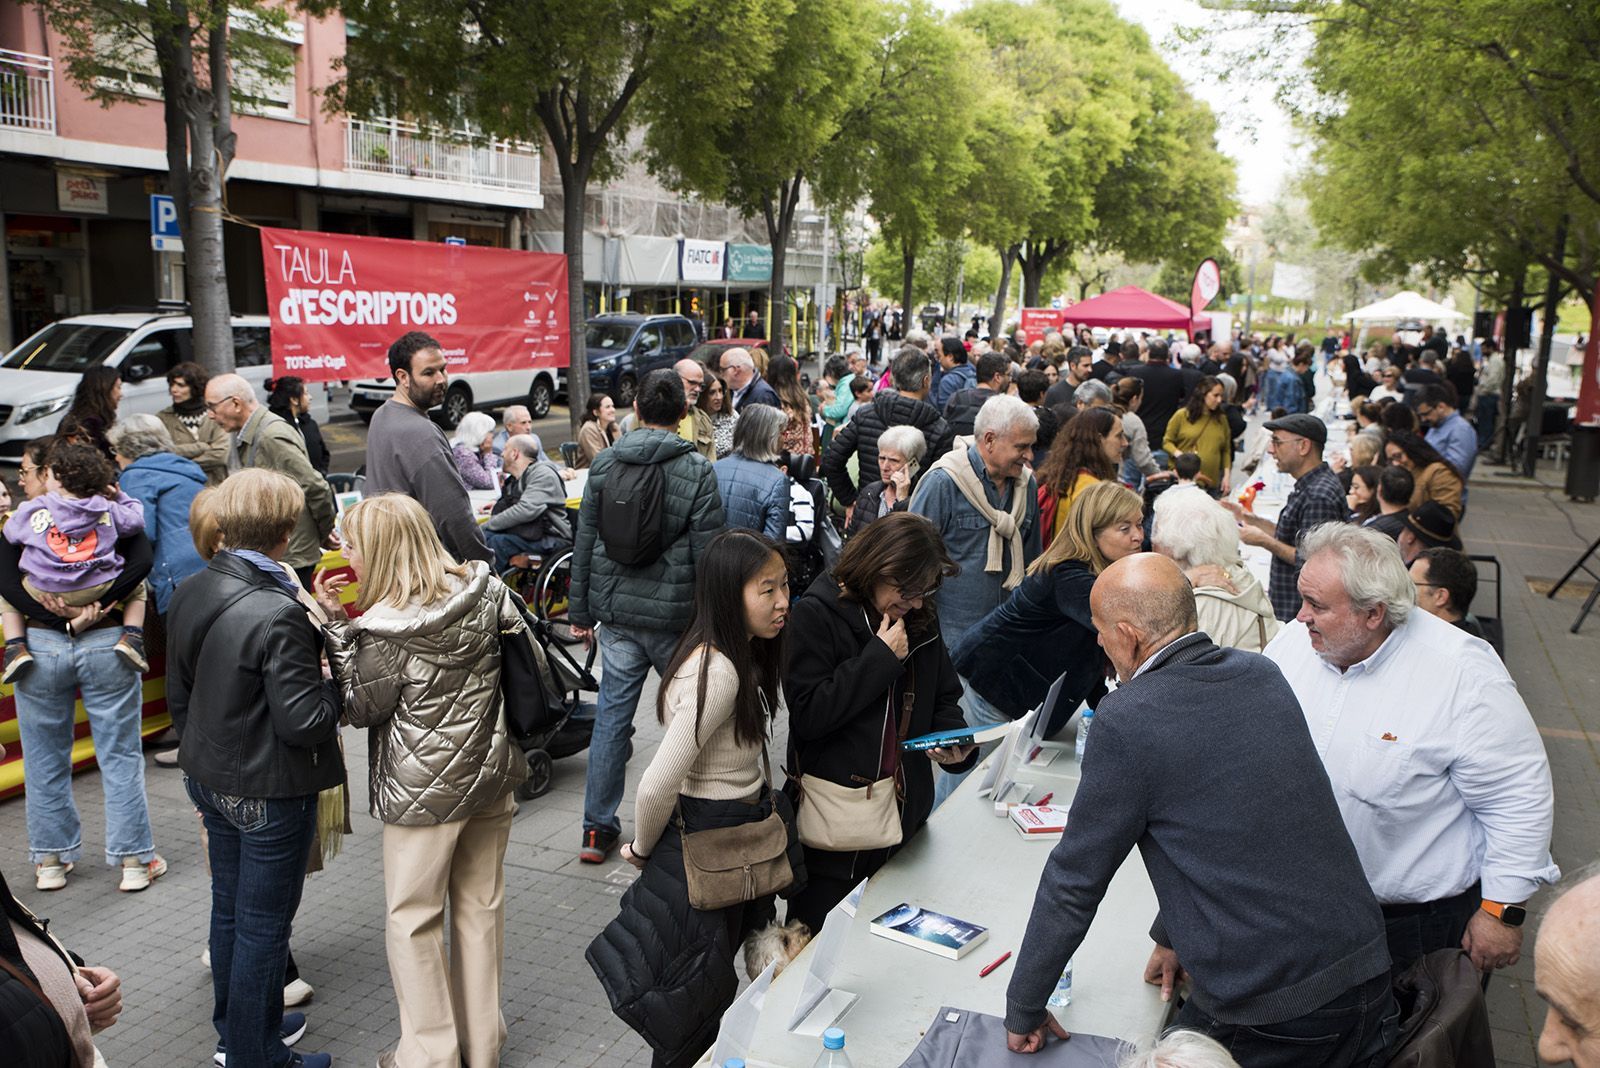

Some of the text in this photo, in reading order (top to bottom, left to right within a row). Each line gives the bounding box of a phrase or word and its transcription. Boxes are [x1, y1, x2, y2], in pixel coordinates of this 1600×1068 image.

[66, 179, 90, 191] pets
[70, 190, 100, 201] place
[158, 200, 177, 232] P
[273, 244, 356, 285] TAULA
[687, 248, 711, 264] FIATC
[279, 288, 457, 325] d'ESCRIPTORS
